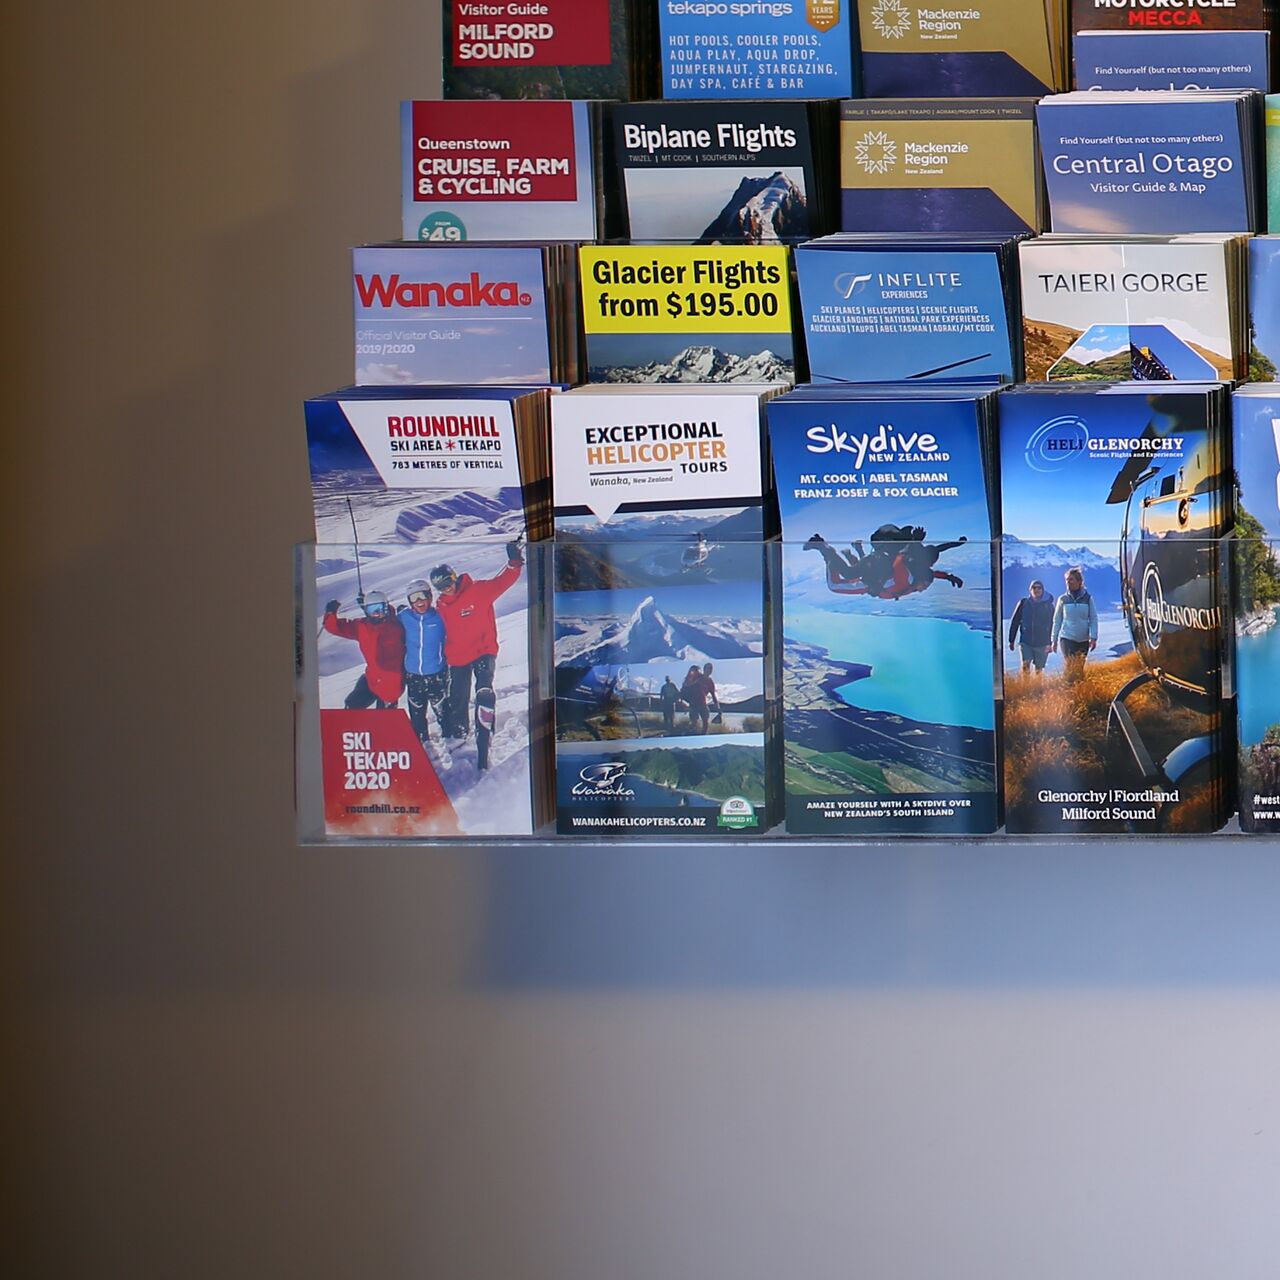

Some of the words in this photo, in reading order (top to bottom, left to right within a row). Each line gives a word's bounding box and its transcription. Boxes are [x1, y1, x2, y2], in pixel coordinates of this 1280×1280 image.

[668, 1, 728, 17] tekapo
[730, 0, 793, 17] springs
[918, 9, 980, 20] Mackenzie
[918, 20, 962, 33] Region
[1128, 10, 1202, 26] MECCA
[458, 24, 554, 41] MILFORD
[459, 44, 535, 59] SOUND
[418, 158, 501, 177] CRUISE,
[506, 158, 569, 175] FARM
[1053, 153, 1146, 175] Central
[1151, 153, 1233, 179] Otago
[437, 178, 532, 195] CYCLING
[592, 260, 687, 285] Glacier
[694, 260, 781, 288] Flights
[878, 273, 962, 287] INFLITE
[1039, 273, 1115, 293] TAIERI
[1121, 273, 1209, 292] GORGE
[599, 293, 658, 317] from
[666, 292, 778, 318] $195.00
[387, 416, 500, 437] ROUNDHILL
[585, 421, 722, 444] EXCEPTIONAL
[806, 423, 939, 469] Skydive
[1087, 437, 1185, 451] GLENORCHY
[586, 441, 727, 465] HELICOPTER
[680, 462, 728, 475] TOURS
[572, 817, 706, 829] WANAKAHELICOPTERS.CO.NZ
